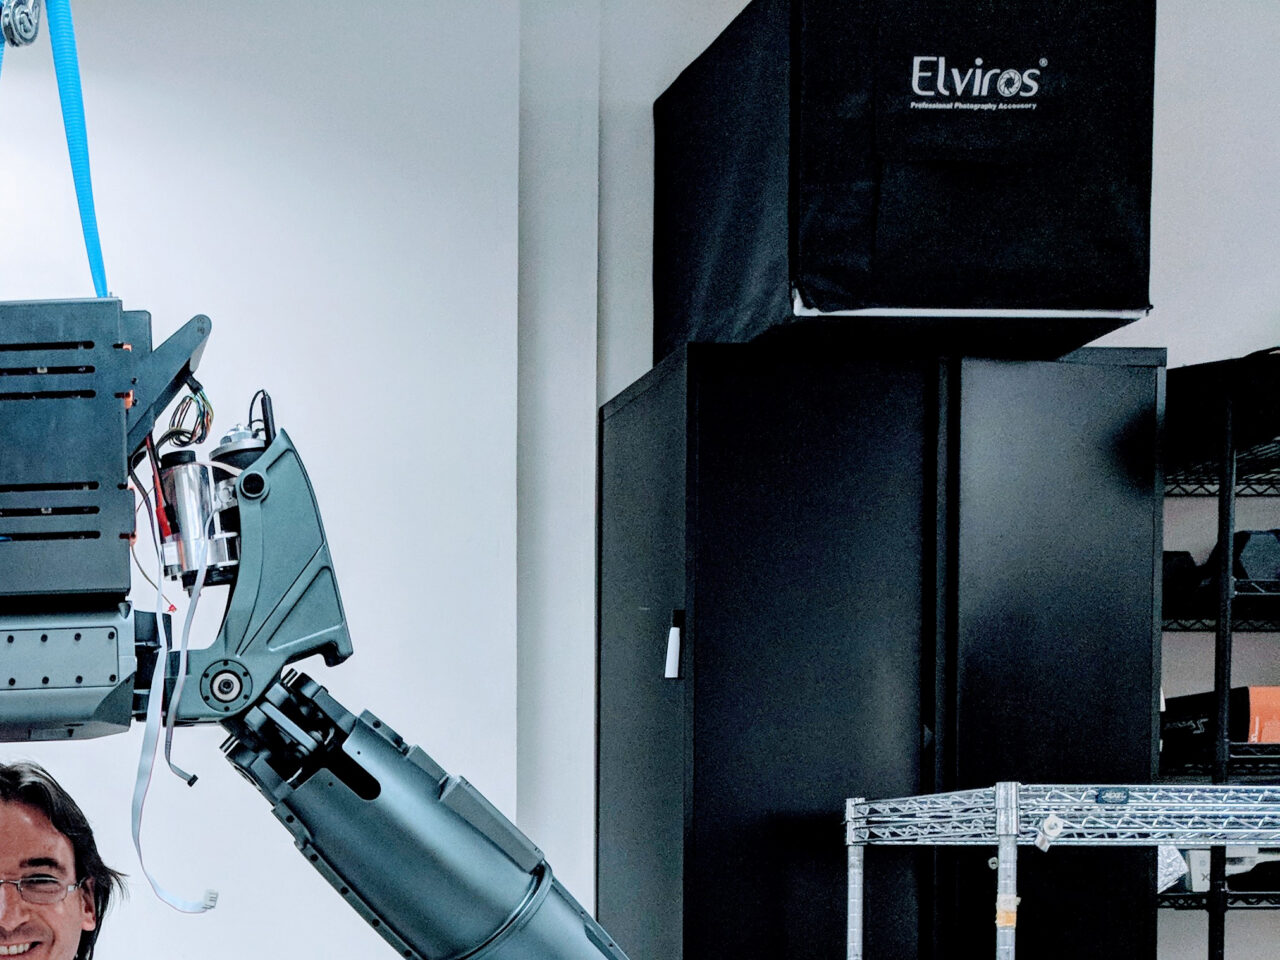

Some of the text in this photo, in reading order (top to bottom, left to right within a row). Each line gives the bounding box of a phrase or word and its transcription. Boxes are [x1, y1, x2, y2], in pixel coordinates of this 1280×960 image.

[910, 102, 1037, 111] Professional Photography Accessory
